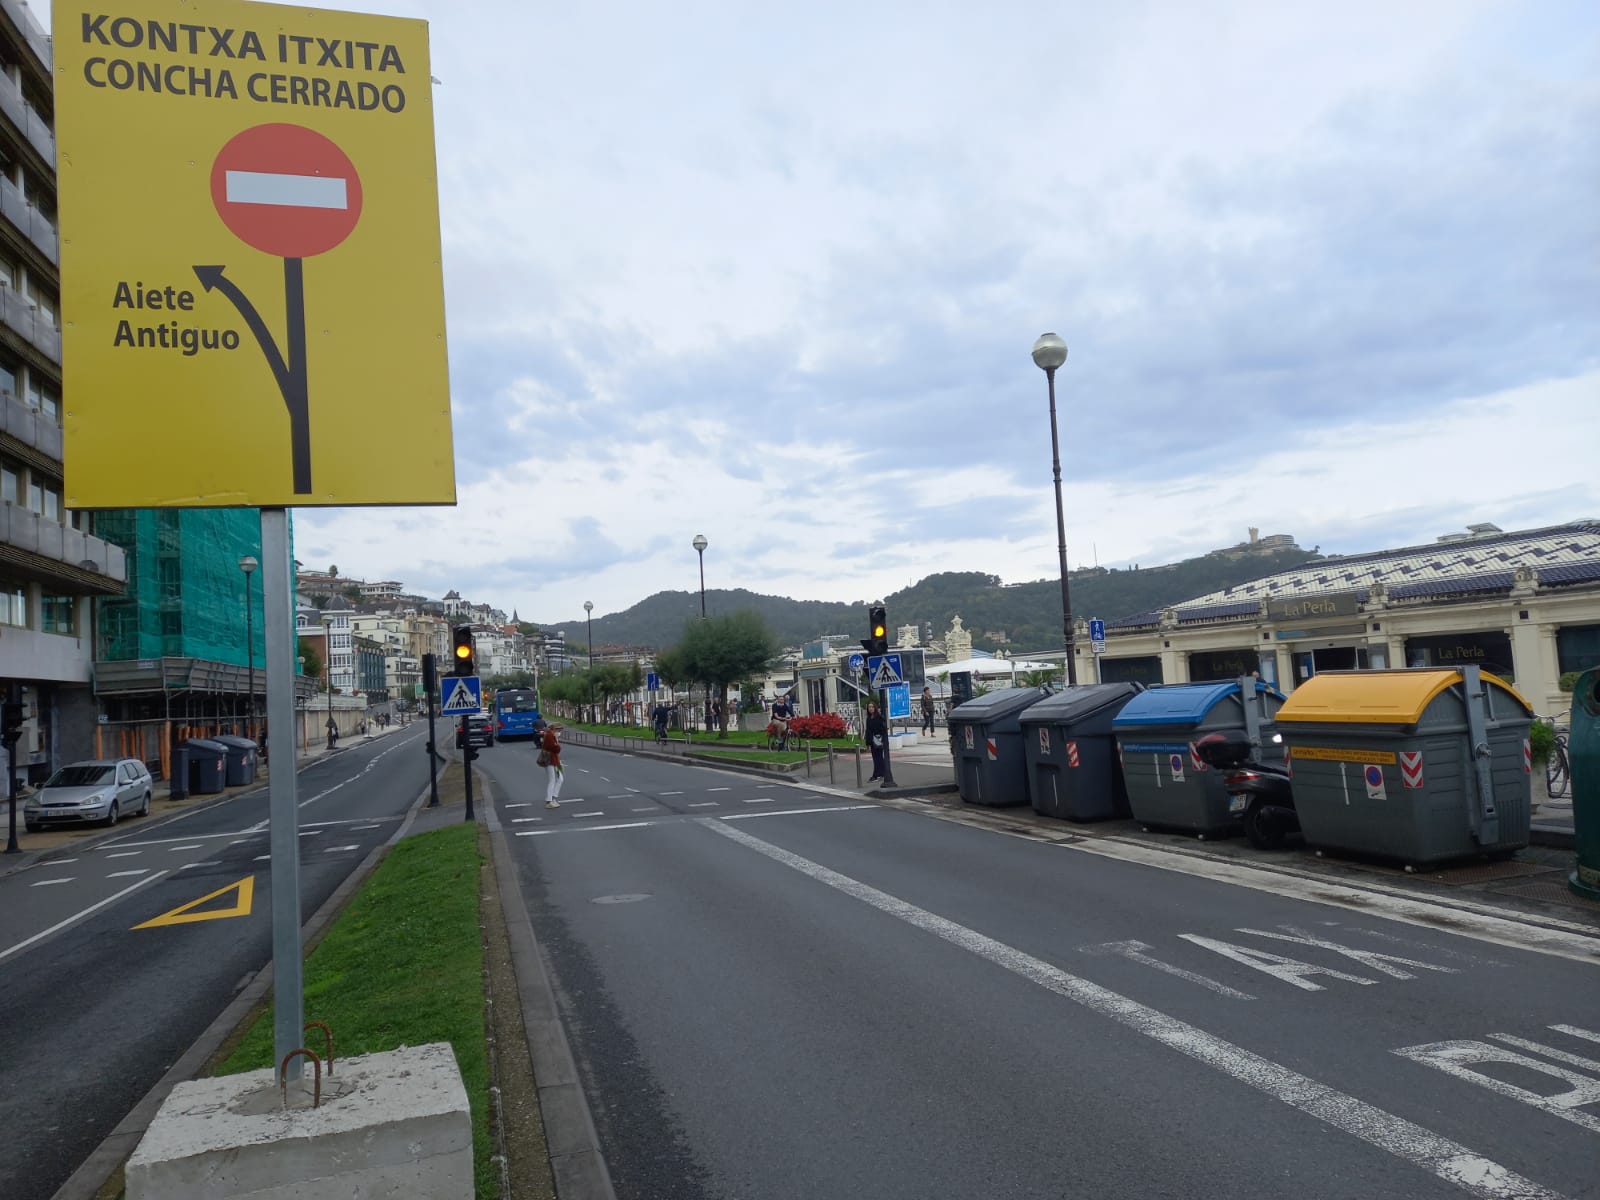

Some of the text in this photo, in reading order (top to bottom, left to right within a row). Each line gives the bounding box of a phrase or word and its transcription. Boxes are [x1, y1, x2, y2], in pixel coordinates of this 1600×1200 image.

[81, 12, 406, 75] KONTXA ITXITA
[83, 56, 407, 114] CONCHA CERRADO
[112, 281, 195, 311] Aiete
[113, 319, 240, 357] Antiguo
[1283, 599, 1337, 617] La Perla
[1438, 644, 1486, 660] La Perla
